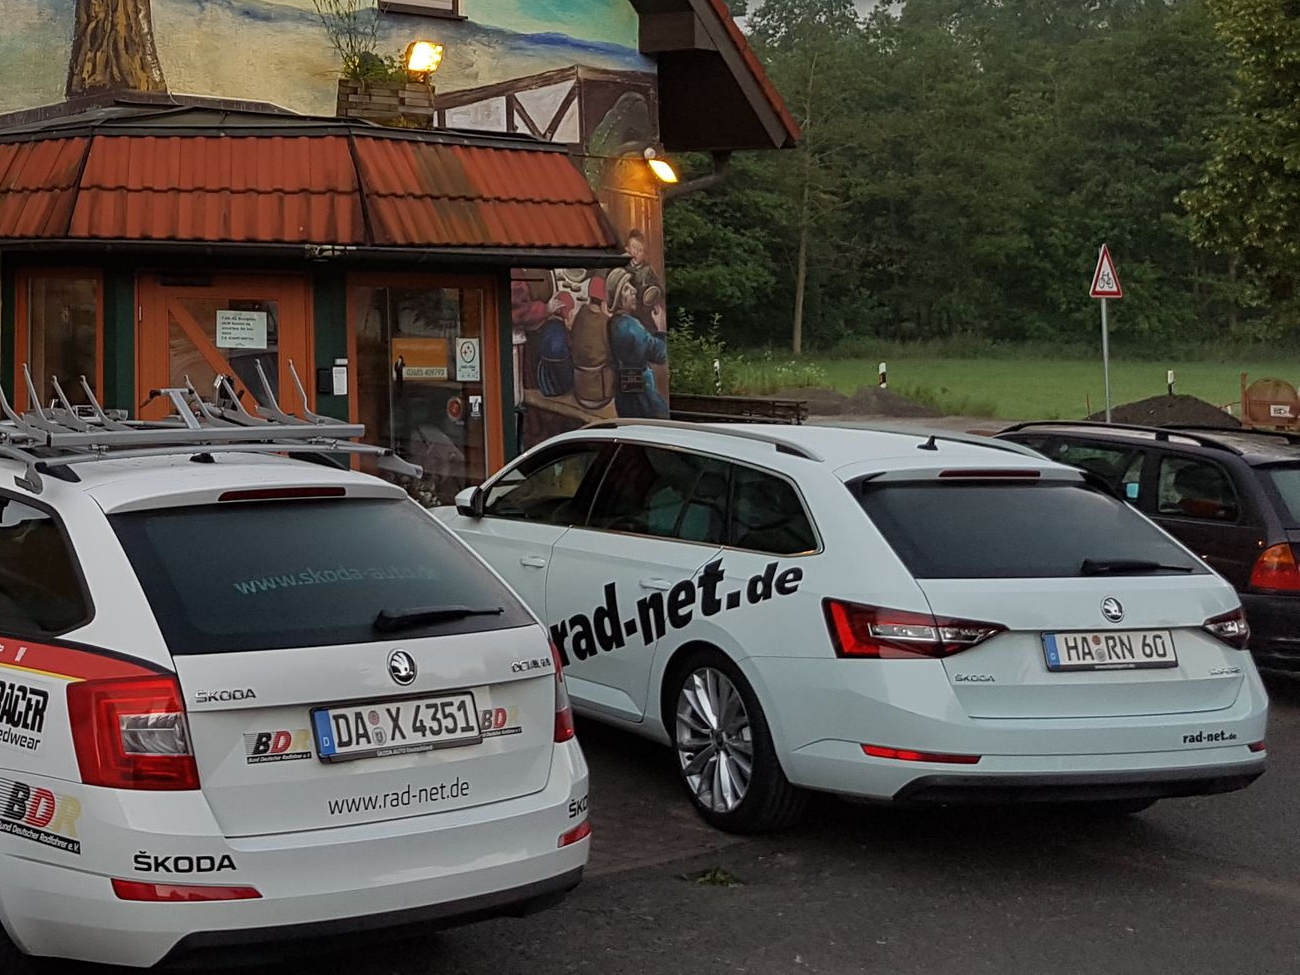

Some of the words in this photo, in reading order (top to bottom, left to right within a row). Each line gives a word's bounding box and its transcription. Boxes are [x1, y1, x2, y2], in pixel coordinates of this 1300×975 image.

[234, 566, 438, 595] www.skoda-auto.
[550, 558, 803, 668] rad-net.de
[1064, 636, 1095, 661] HA
[1104, 635, 1135, 660] RN
[1141, 634, 1167, 658] 60
[332, 711, 372, 747] DA
[385, 706, 407, 741] X
[412, 700, 474, 736] 4351
[1182, 730, 1237, 744] rad-net.de
[328, 777, 470, 816] www.rad-net.de
[133, 850, 237, 874] ŠKODA
